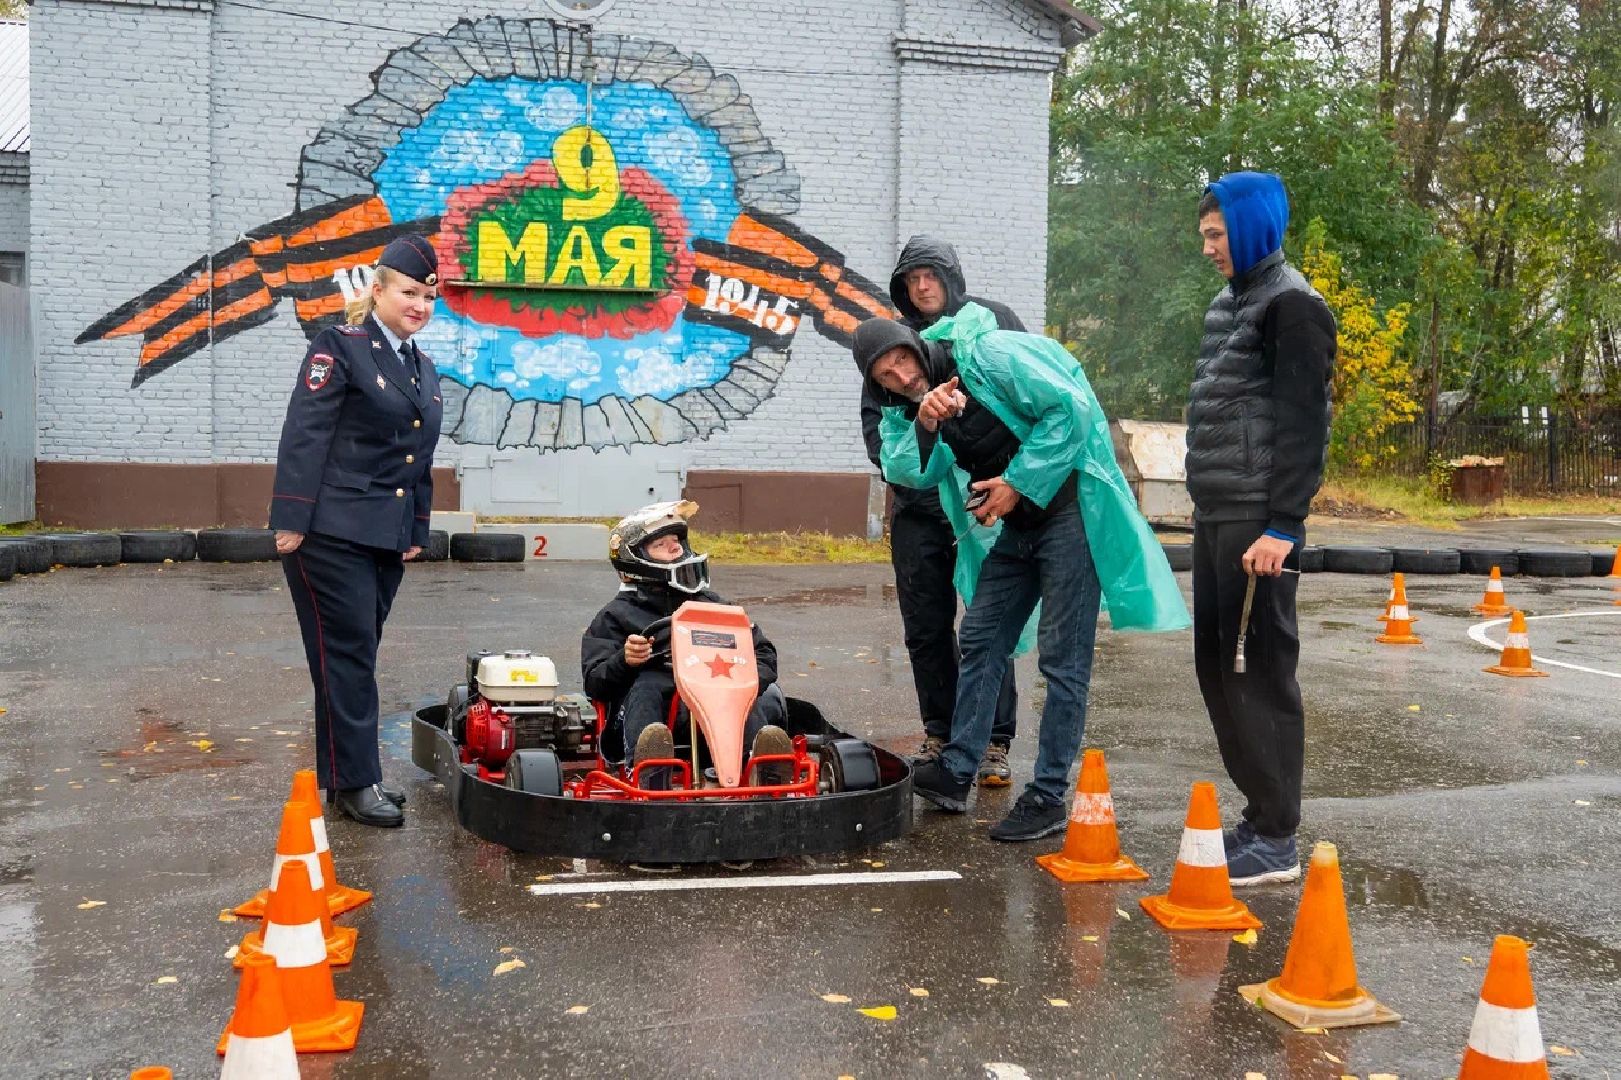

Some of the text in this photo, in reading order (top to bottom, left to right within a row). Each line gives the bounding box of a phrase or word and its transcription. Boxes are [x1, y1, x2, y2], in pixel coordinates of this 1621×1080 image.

[551, 125, 620, 221] 9
[477, 221, 652, 289] МАЯ
[700, 272, 800, 335] 1945
[533, 535, 548, 558] 2
